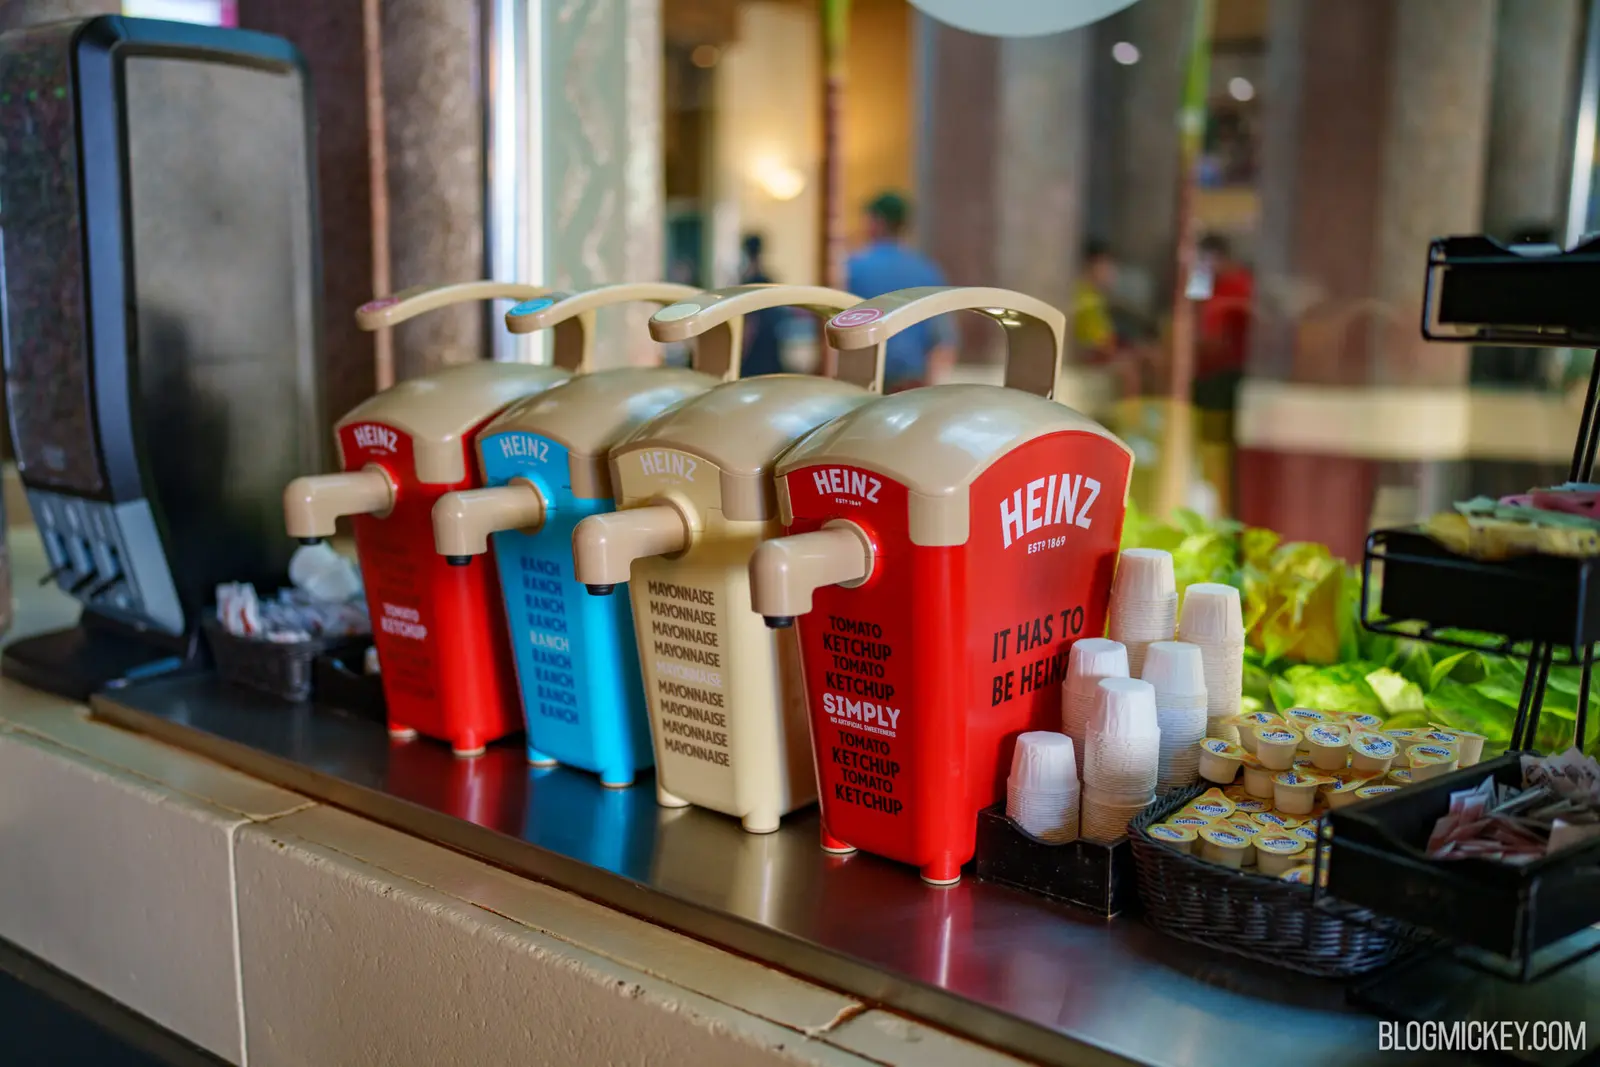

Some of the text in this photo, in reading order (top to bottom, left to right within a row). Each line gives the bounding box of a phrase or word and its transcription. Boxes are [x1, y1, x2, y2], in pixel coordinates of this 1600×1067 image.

[353, 424, 398, 453] HEINZ
[500, 435, 549, 463] HEINZ
[640, 451, 697, 482] HEINZ
[812, 468, 882, 504] HEINZ
[1000, 473, 1101, 550] HEINZ
[1047, 535, 1066, 549] 1869
[520, 556, 561, 577] RANCH
[522, 574, 563, 597] RANCH
[648, 580, 715, 606] MAYONNAISE
[525, 594, 565, 615] RANCH
[650, 600, 717, 627] MAYONNAISE
[527, 612, 567, 633] RANCH
[652, 620, 719, 647] MAYONNAISE
[828, 616, 883, 639] TOMATO
[991, 605, 1085, 664] IT HAS TO
[530, 630, 570, 652] RANCH
[654, 640, 721, 668] MAYONNAISE
[822, 632, 892, 662] KETCHUP
[532, 648, 572, 670] RANCH
[832, 655, 885, 678] TOMATO
[535, 666, 575, 689] RANCH
[825, 671, 895, 701] KETCHUP
[991, 672, 1014, 707] BE
[537, 684, 577, 707] RANCH
[658, 679, 724, 708] MAYONNAISE
[540, 702, 580, 725] RANCH
[660, 699, 727, 728] MAYONNAISE
[822, 692, 900, 729] SIMPLY
[662, 718, 729, 747] MAYONNAISE
[838, 731, 890, 756] TOMATO
[664, 737, 730, 767] MAYONNAISE
[832, 747, 901, 779] KETCHUP
[840, 767, 893, 794] TOMATO
[834, 783, 904, 816] KETCHUP
